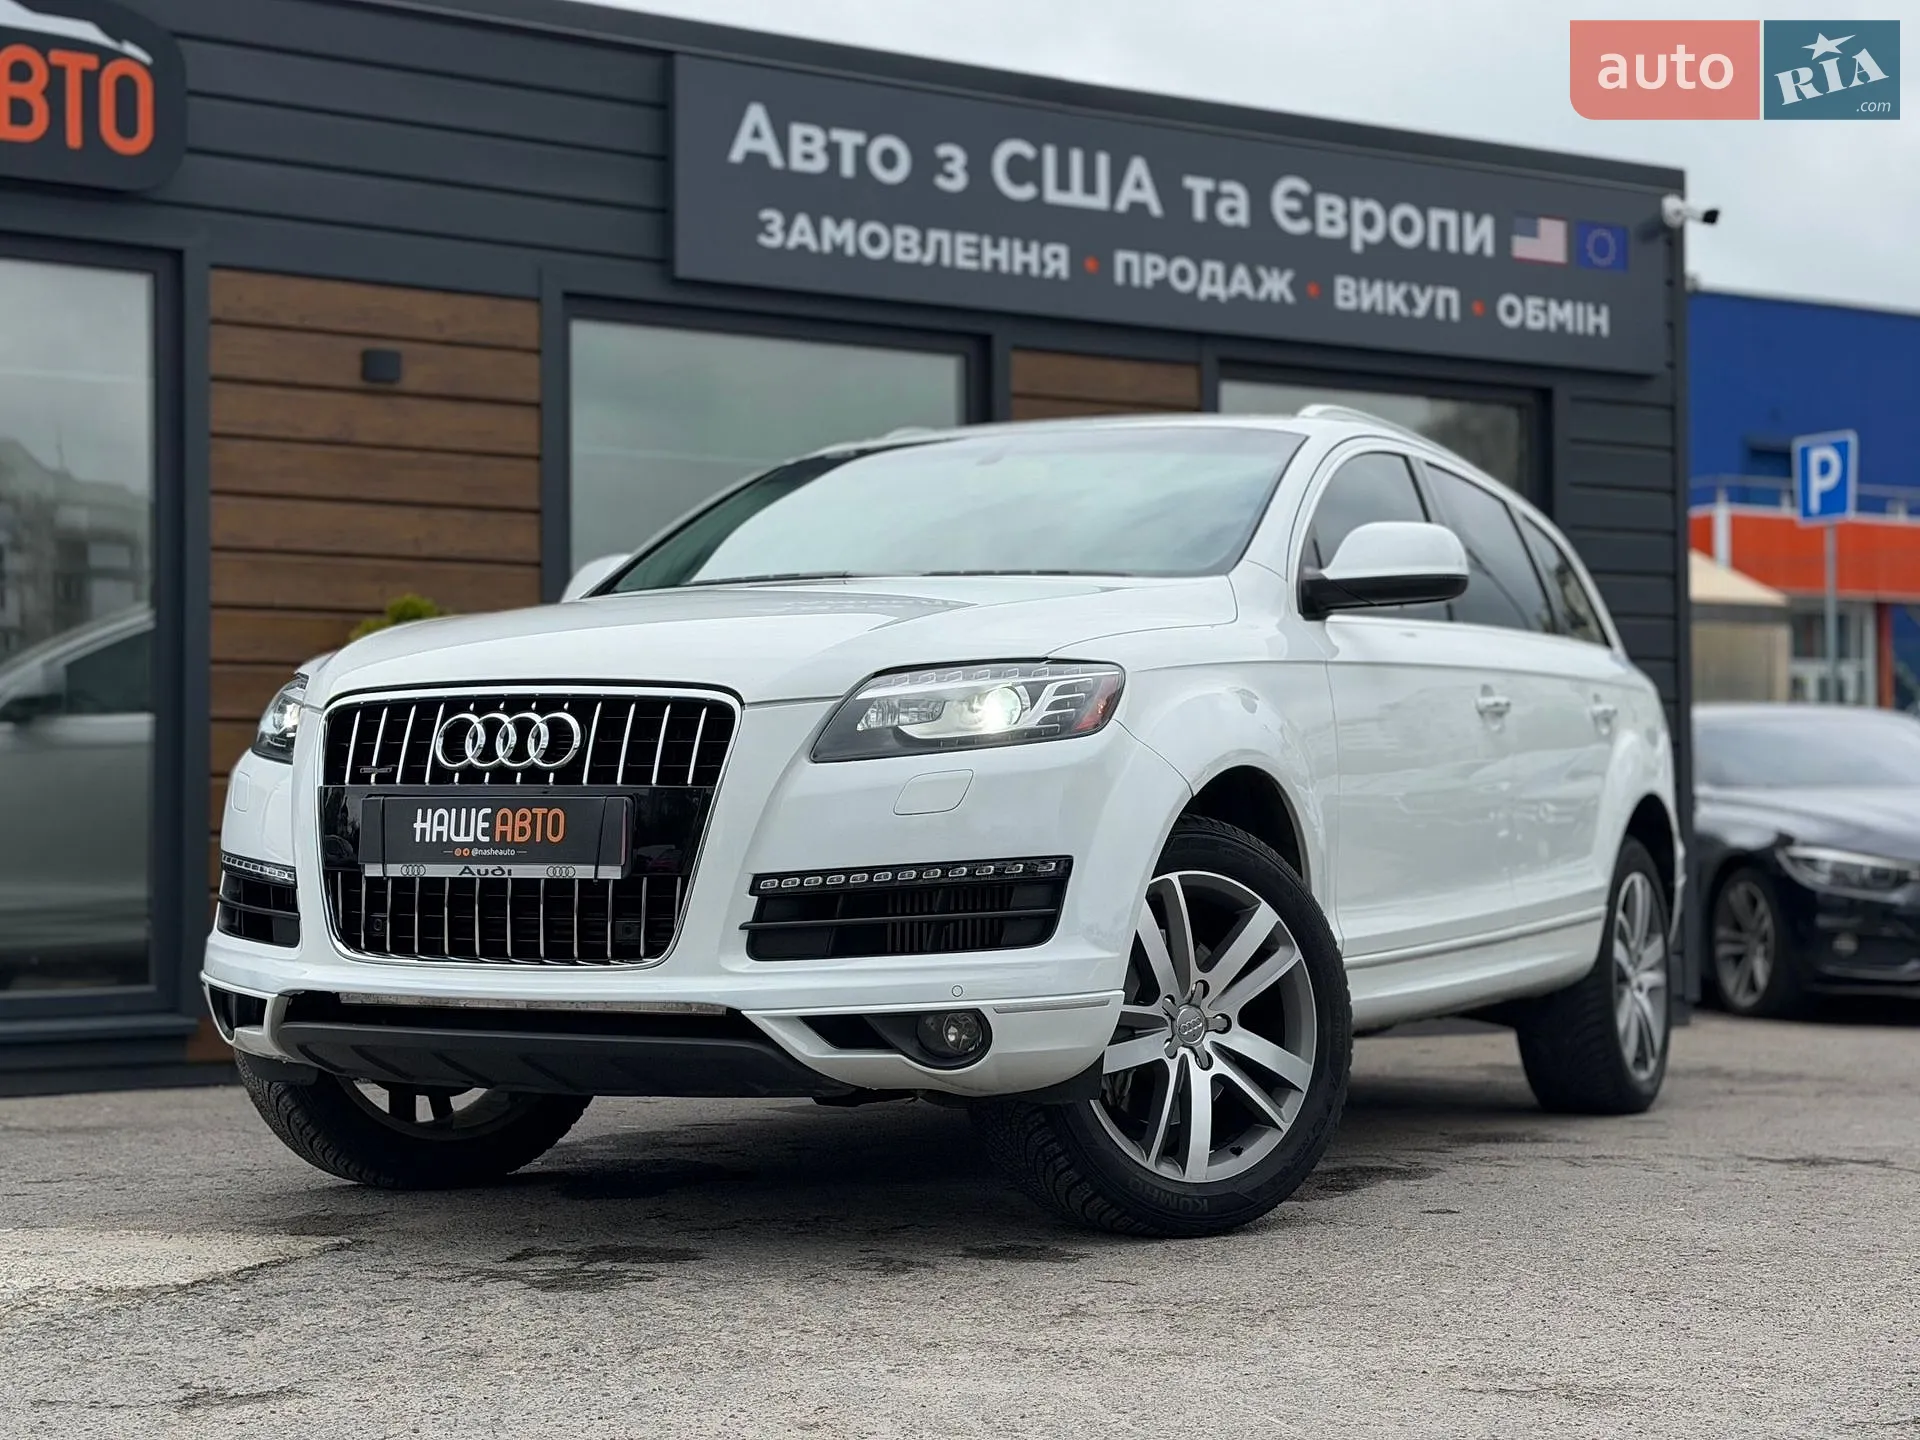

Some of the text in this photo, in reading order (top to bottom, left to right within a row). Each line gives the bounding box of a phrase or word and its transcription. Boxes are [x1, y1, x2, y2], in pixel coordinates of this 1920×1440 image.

[728, 102, 1495, 258] Авто з США та Європи
[757, 208, 1610, 337] ЗАМОВЛЕННЯ ПРОДАЖ ВИКУП ОБМІН
[1808, 445, 1843, 515] P
[413, 808, 565, 843] НАШЕ АВТО
[458, 866, 513, 876] Audi
[471, 848, 516, 856] @nasheauto
